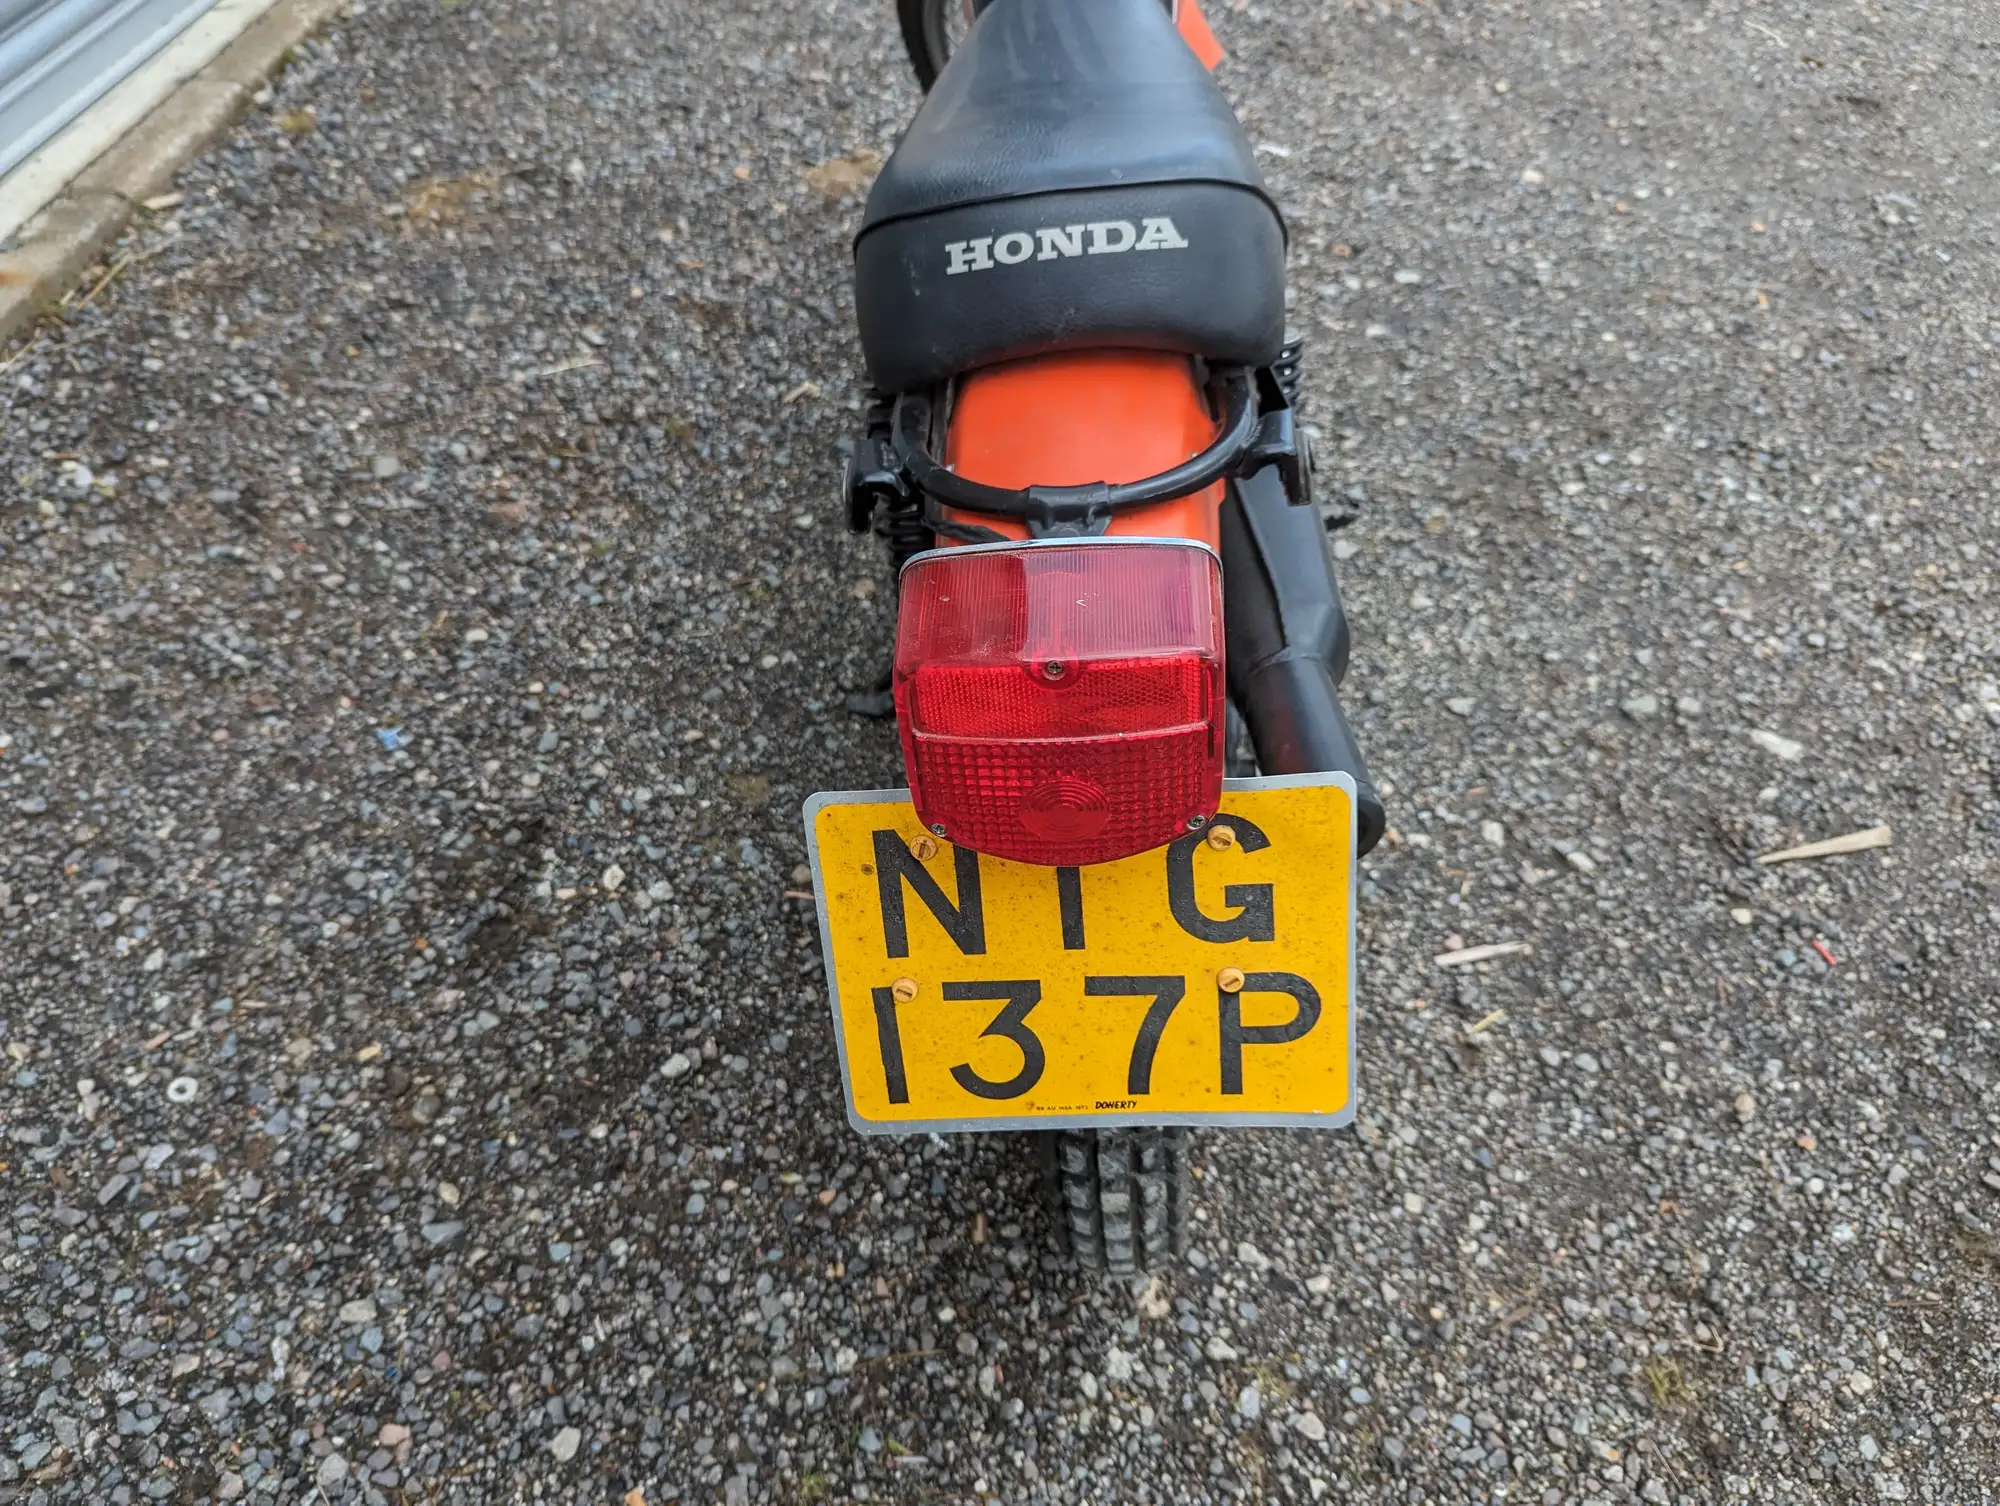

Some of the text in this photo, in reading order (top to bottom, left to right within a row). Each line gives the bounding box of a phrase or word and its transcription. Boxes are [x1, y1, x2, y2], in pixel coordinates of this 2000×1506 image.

[945, 217, 1189, 275] HONDA
[871, 972, 1321, 1104] 137P
[1095, 1100, 1138, 1110] DOHERTY
